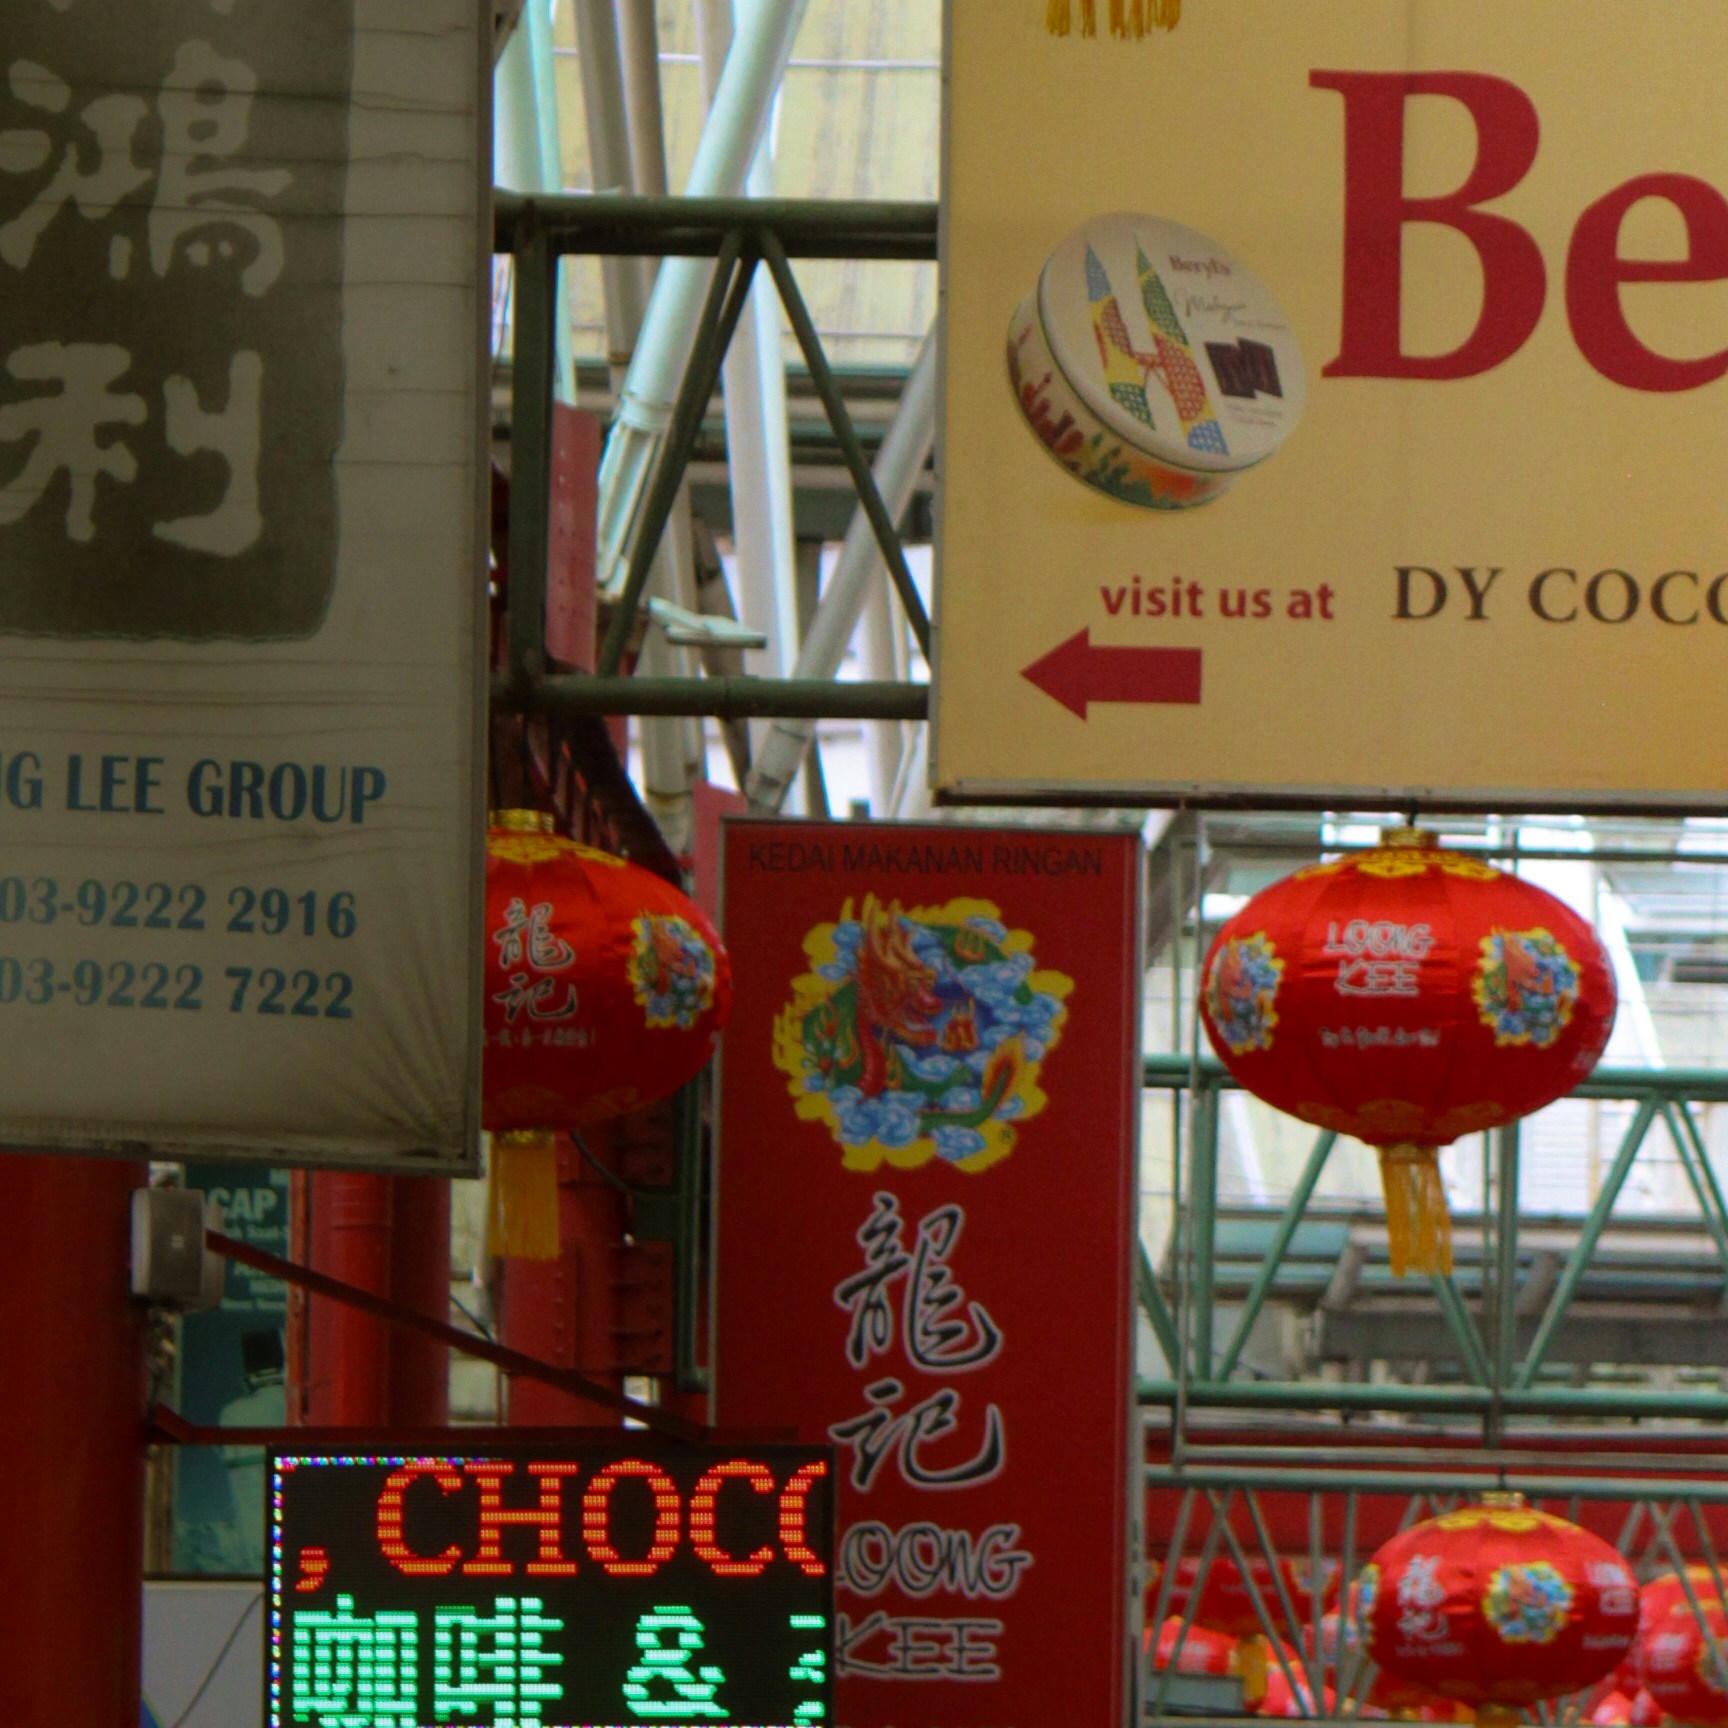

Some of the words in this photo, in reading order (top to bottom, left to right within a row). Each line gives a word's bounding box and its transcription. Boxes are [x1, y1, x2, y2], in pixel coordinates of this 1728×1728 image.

[1100, 576, 1205, 618] visit
[1218, 583, 1273, 619] us
[1287, 582, 1335, 620] at
[1392, 566, 1504, 621] DY
[0, 751, 42, 810] G
[66, 754, 165, 814] LEE
[187, 758, 387, 824] GROUP
[750, 842, 835, 872] KEDAI
[842, 843, 984, 874] MAKANAN
[993, 844, 1103, 877] RINGAN
[0, 876, 206, 930] 03-9222
[227, 886, 358, 939] 2916
[1322, 918, 1437, 957] LOONG
[0, 956, 204, 1011] 03-9222
[224, 967, 354, 1019] 7222
[1333, 960, 1421, 997] KEE
[829, 1190, 1003, 1491] 龍記
[835, 1520, 1035, 1600] OONG
[622, 1605, 731, 1718] &
[835, 1610, 1005, 1683] KEE
